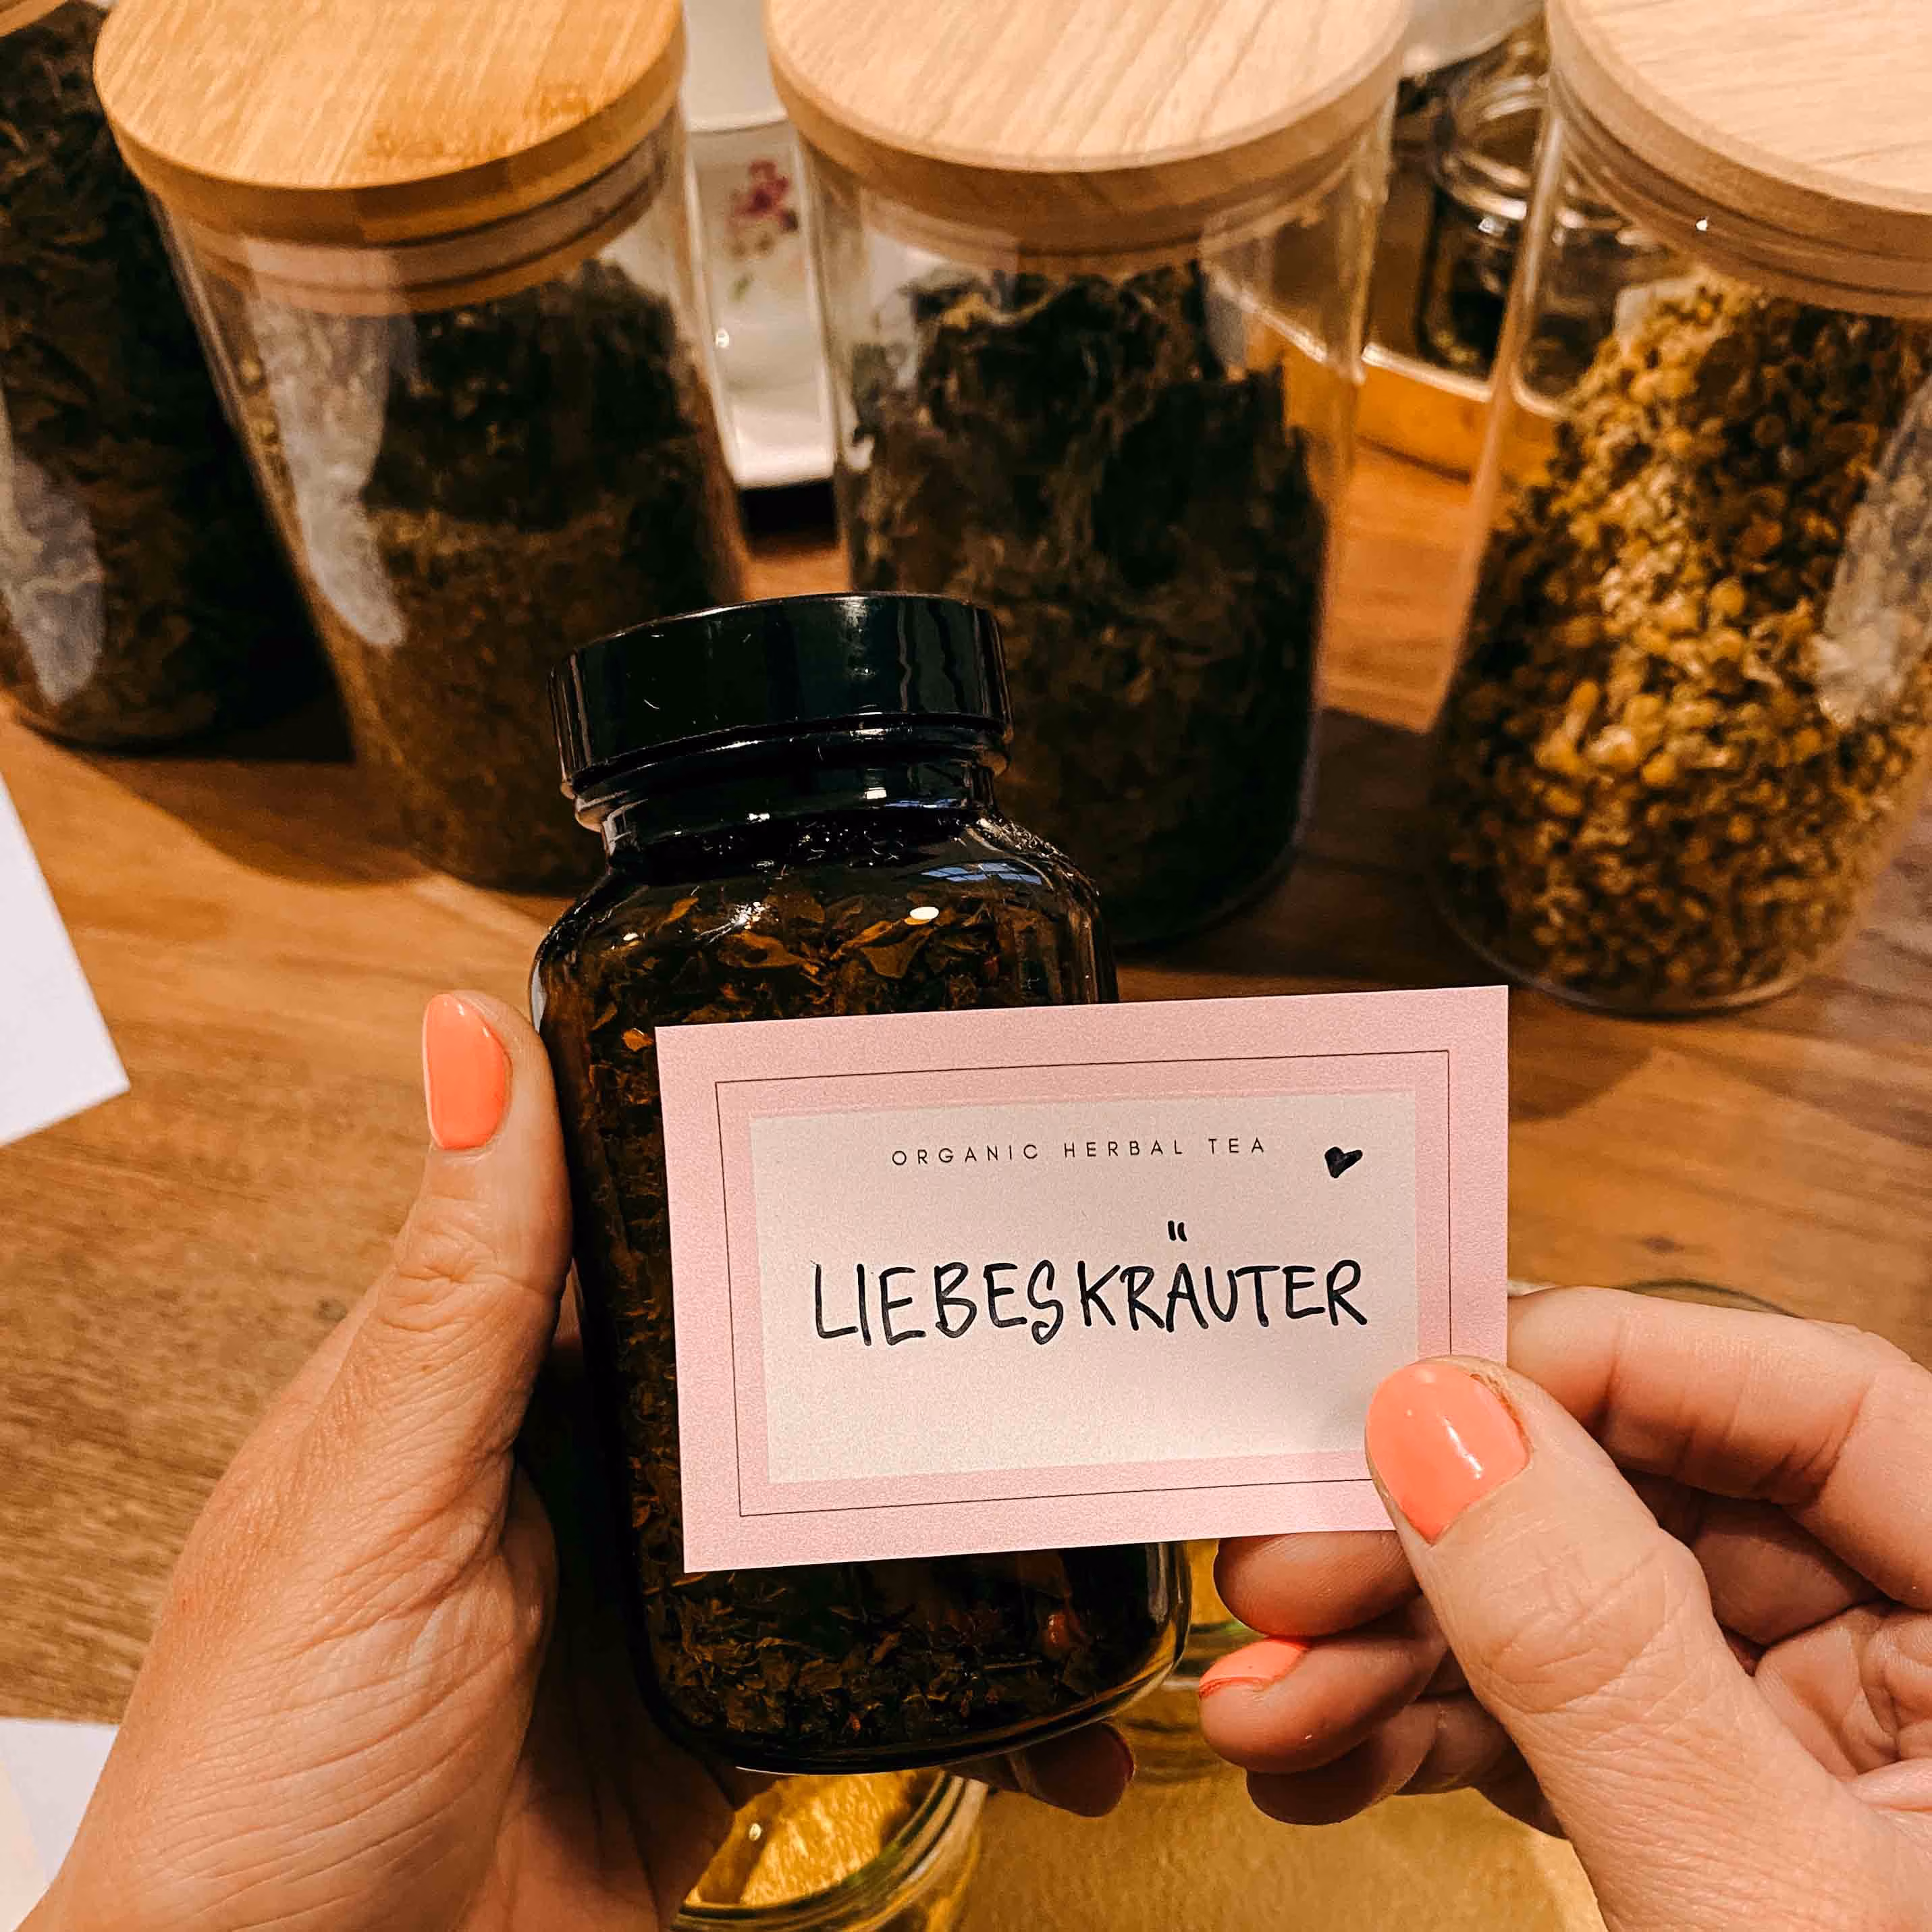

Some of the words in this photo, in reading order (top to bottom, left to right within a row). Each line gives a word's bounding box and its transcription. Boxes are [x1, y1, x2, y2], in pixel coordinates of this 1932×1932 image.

[891, 1143, 1038, 1166] ORGANIC
[1063, 1138, 1183, 1158] HERBAL
[1208, 1137, 1264, 1155] TEA
[809, 1220, 1368, 1347] LIEBESKRÄUTER
